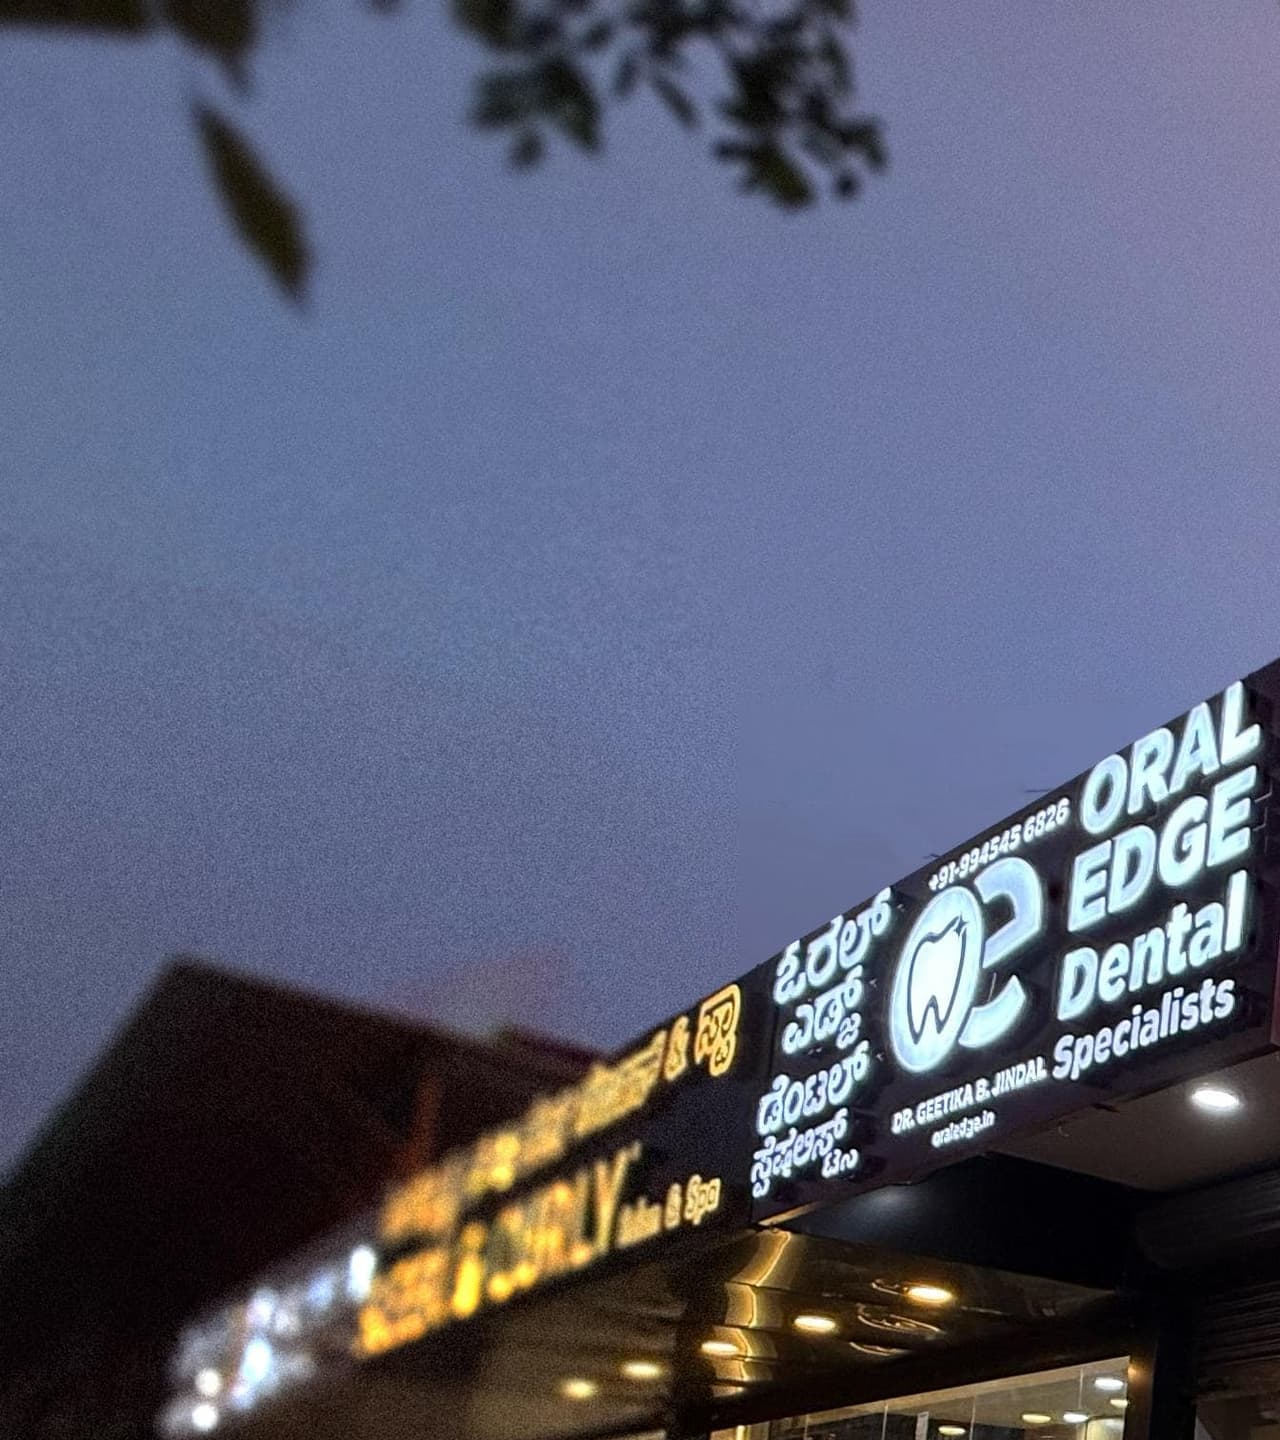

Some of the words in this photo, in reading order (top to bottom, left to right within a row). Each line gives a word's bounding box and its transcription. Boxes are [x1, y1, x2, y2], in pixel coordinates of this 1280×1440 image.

[1080, 680, 1261, 834] ORAL
[928, 824, 1022, 891] +91-994545
[1023, 797, 1070, 843] 6826
[1066, 765, 1257, 932] EDGE
[773, 886, 891, 1005] ಓರಲ್
[1057, 870, 1248, 1022] Dental
[1052, 974, 1235, 1081] Specialists
[757, 1040, 870, 1136] ಡೆಂಟಲ್
[891, 1107, 915, 1135] DR.
[916, 1083, 973, 1125] GEETIKA
[975, 1077, 990, 1102] B.
[991, 1056, 1048, 1096] JINDAL
[684, 1174, 721, 1226] Spa
